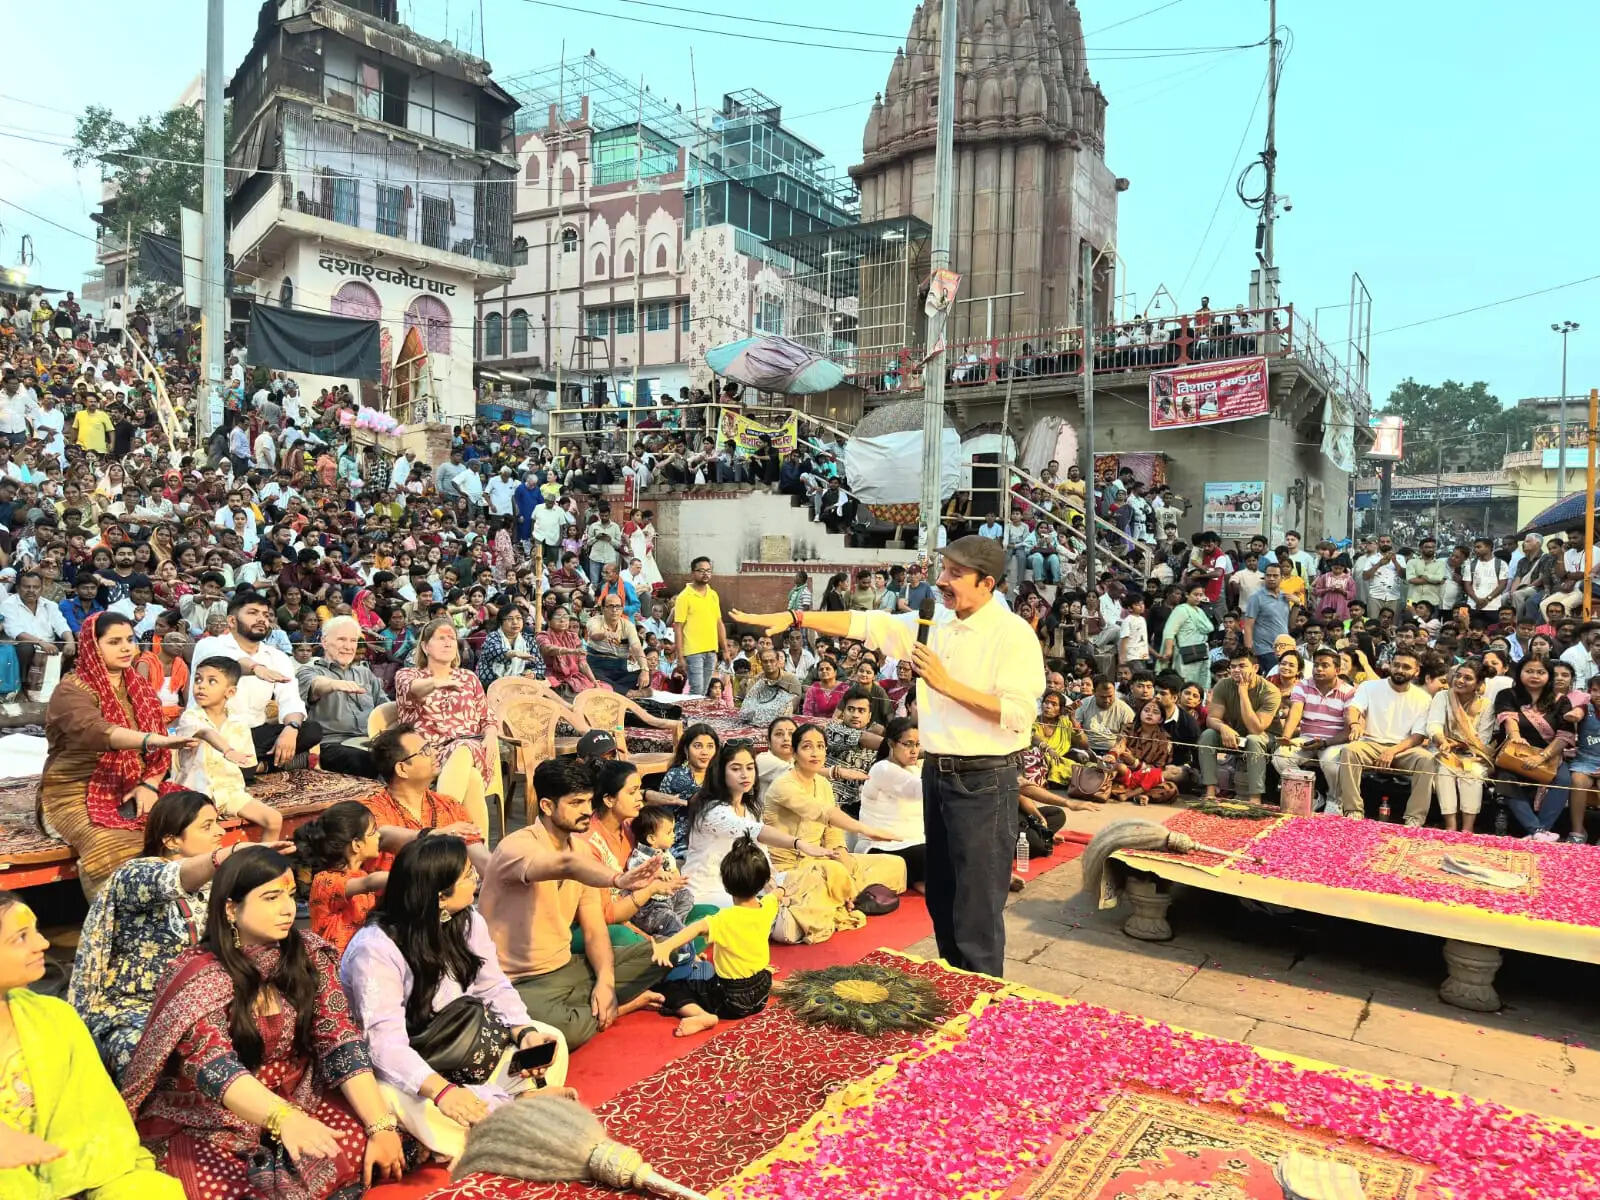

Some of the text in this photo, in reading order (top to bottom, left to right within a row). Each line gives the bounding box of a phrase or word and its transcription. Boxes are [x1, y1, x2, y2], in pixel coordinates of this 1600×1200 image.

[319, 256, 424, 289] दशाश्वमेध
[425, 279, 457, 297] घाट
[1176, 379, 1217, 394] विशाल
